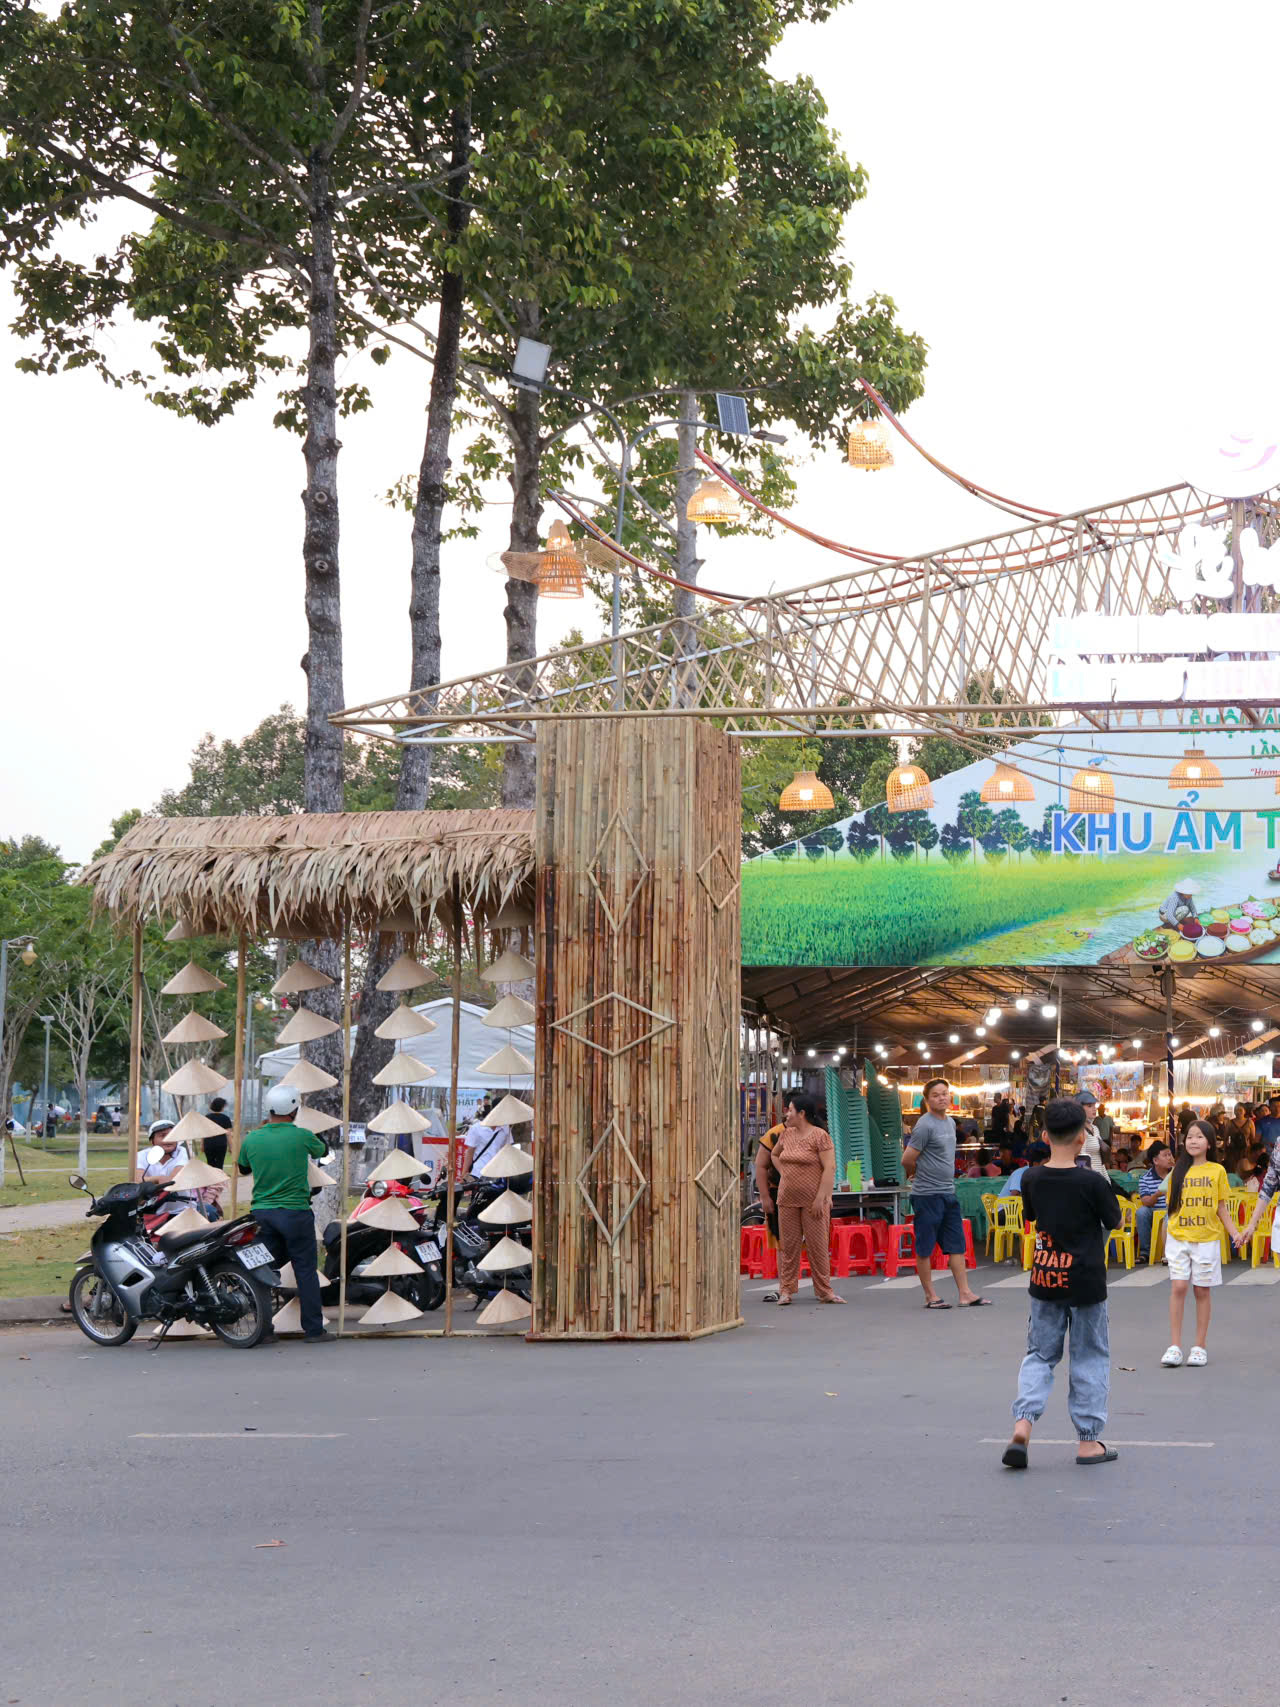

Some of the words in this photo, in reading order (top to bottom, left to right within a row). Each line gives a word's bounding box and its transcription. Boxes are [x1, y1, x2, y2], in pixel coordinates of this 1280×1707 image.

[1054, 812, 1152, 851] KHU
[1166, 790, 1242, 850] ẨM
[1185, 1196, 1213, 1207] orld
